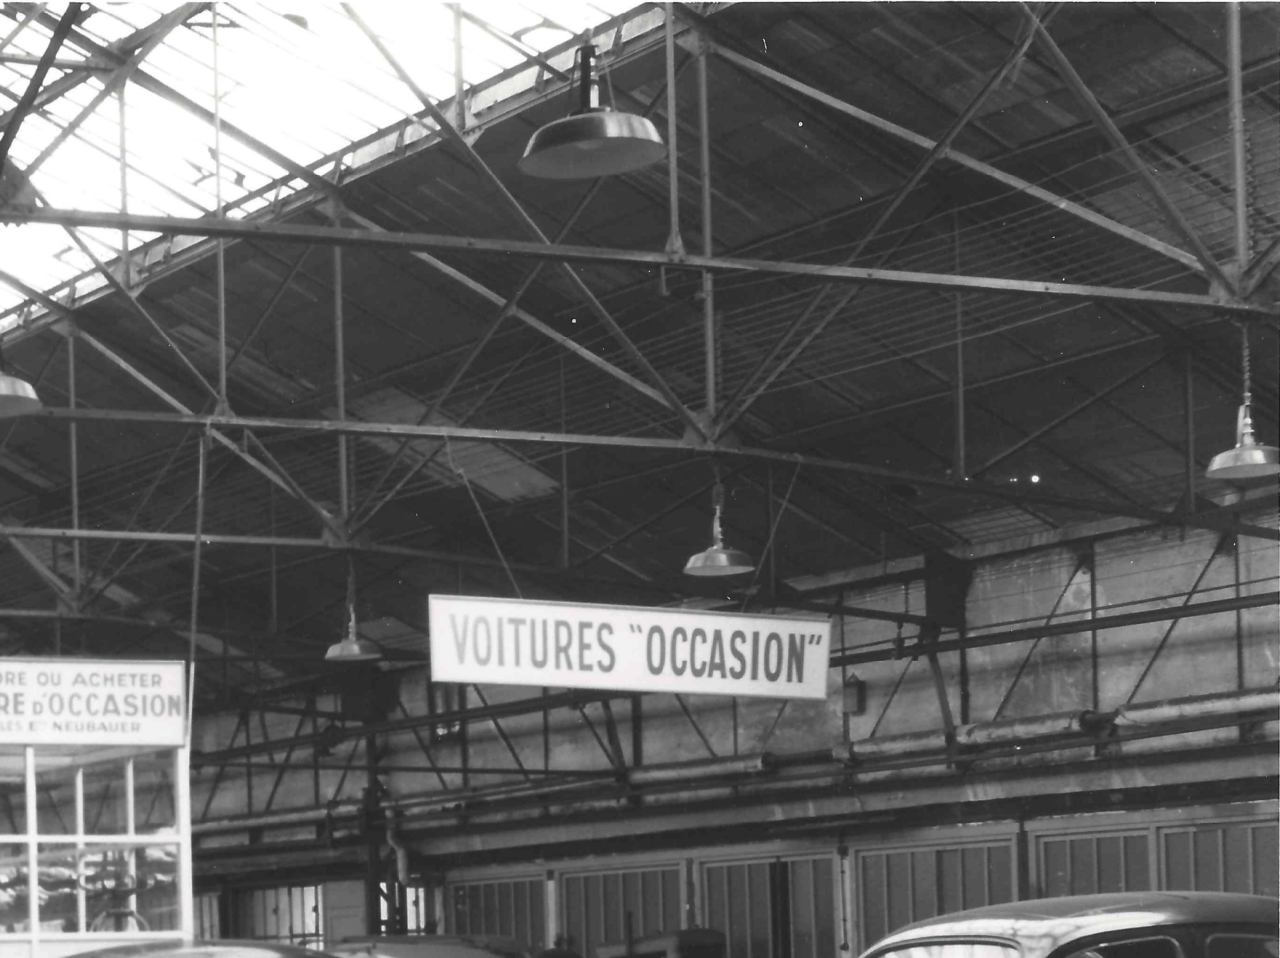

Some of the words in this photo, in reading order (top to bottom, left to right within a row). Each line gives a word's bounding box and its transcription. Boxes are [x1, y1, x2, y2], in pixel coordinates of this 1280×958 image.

[449, 613, 616, 673] VOITURES
[629, 623, 822, 684] "OCCASION"
[37, 671, 61, 687] OU
[72, 672, 162, 688] ACHETER
[0, 719, 21, 732] LES
[53, 721, 141, 733] NEUBAUER
